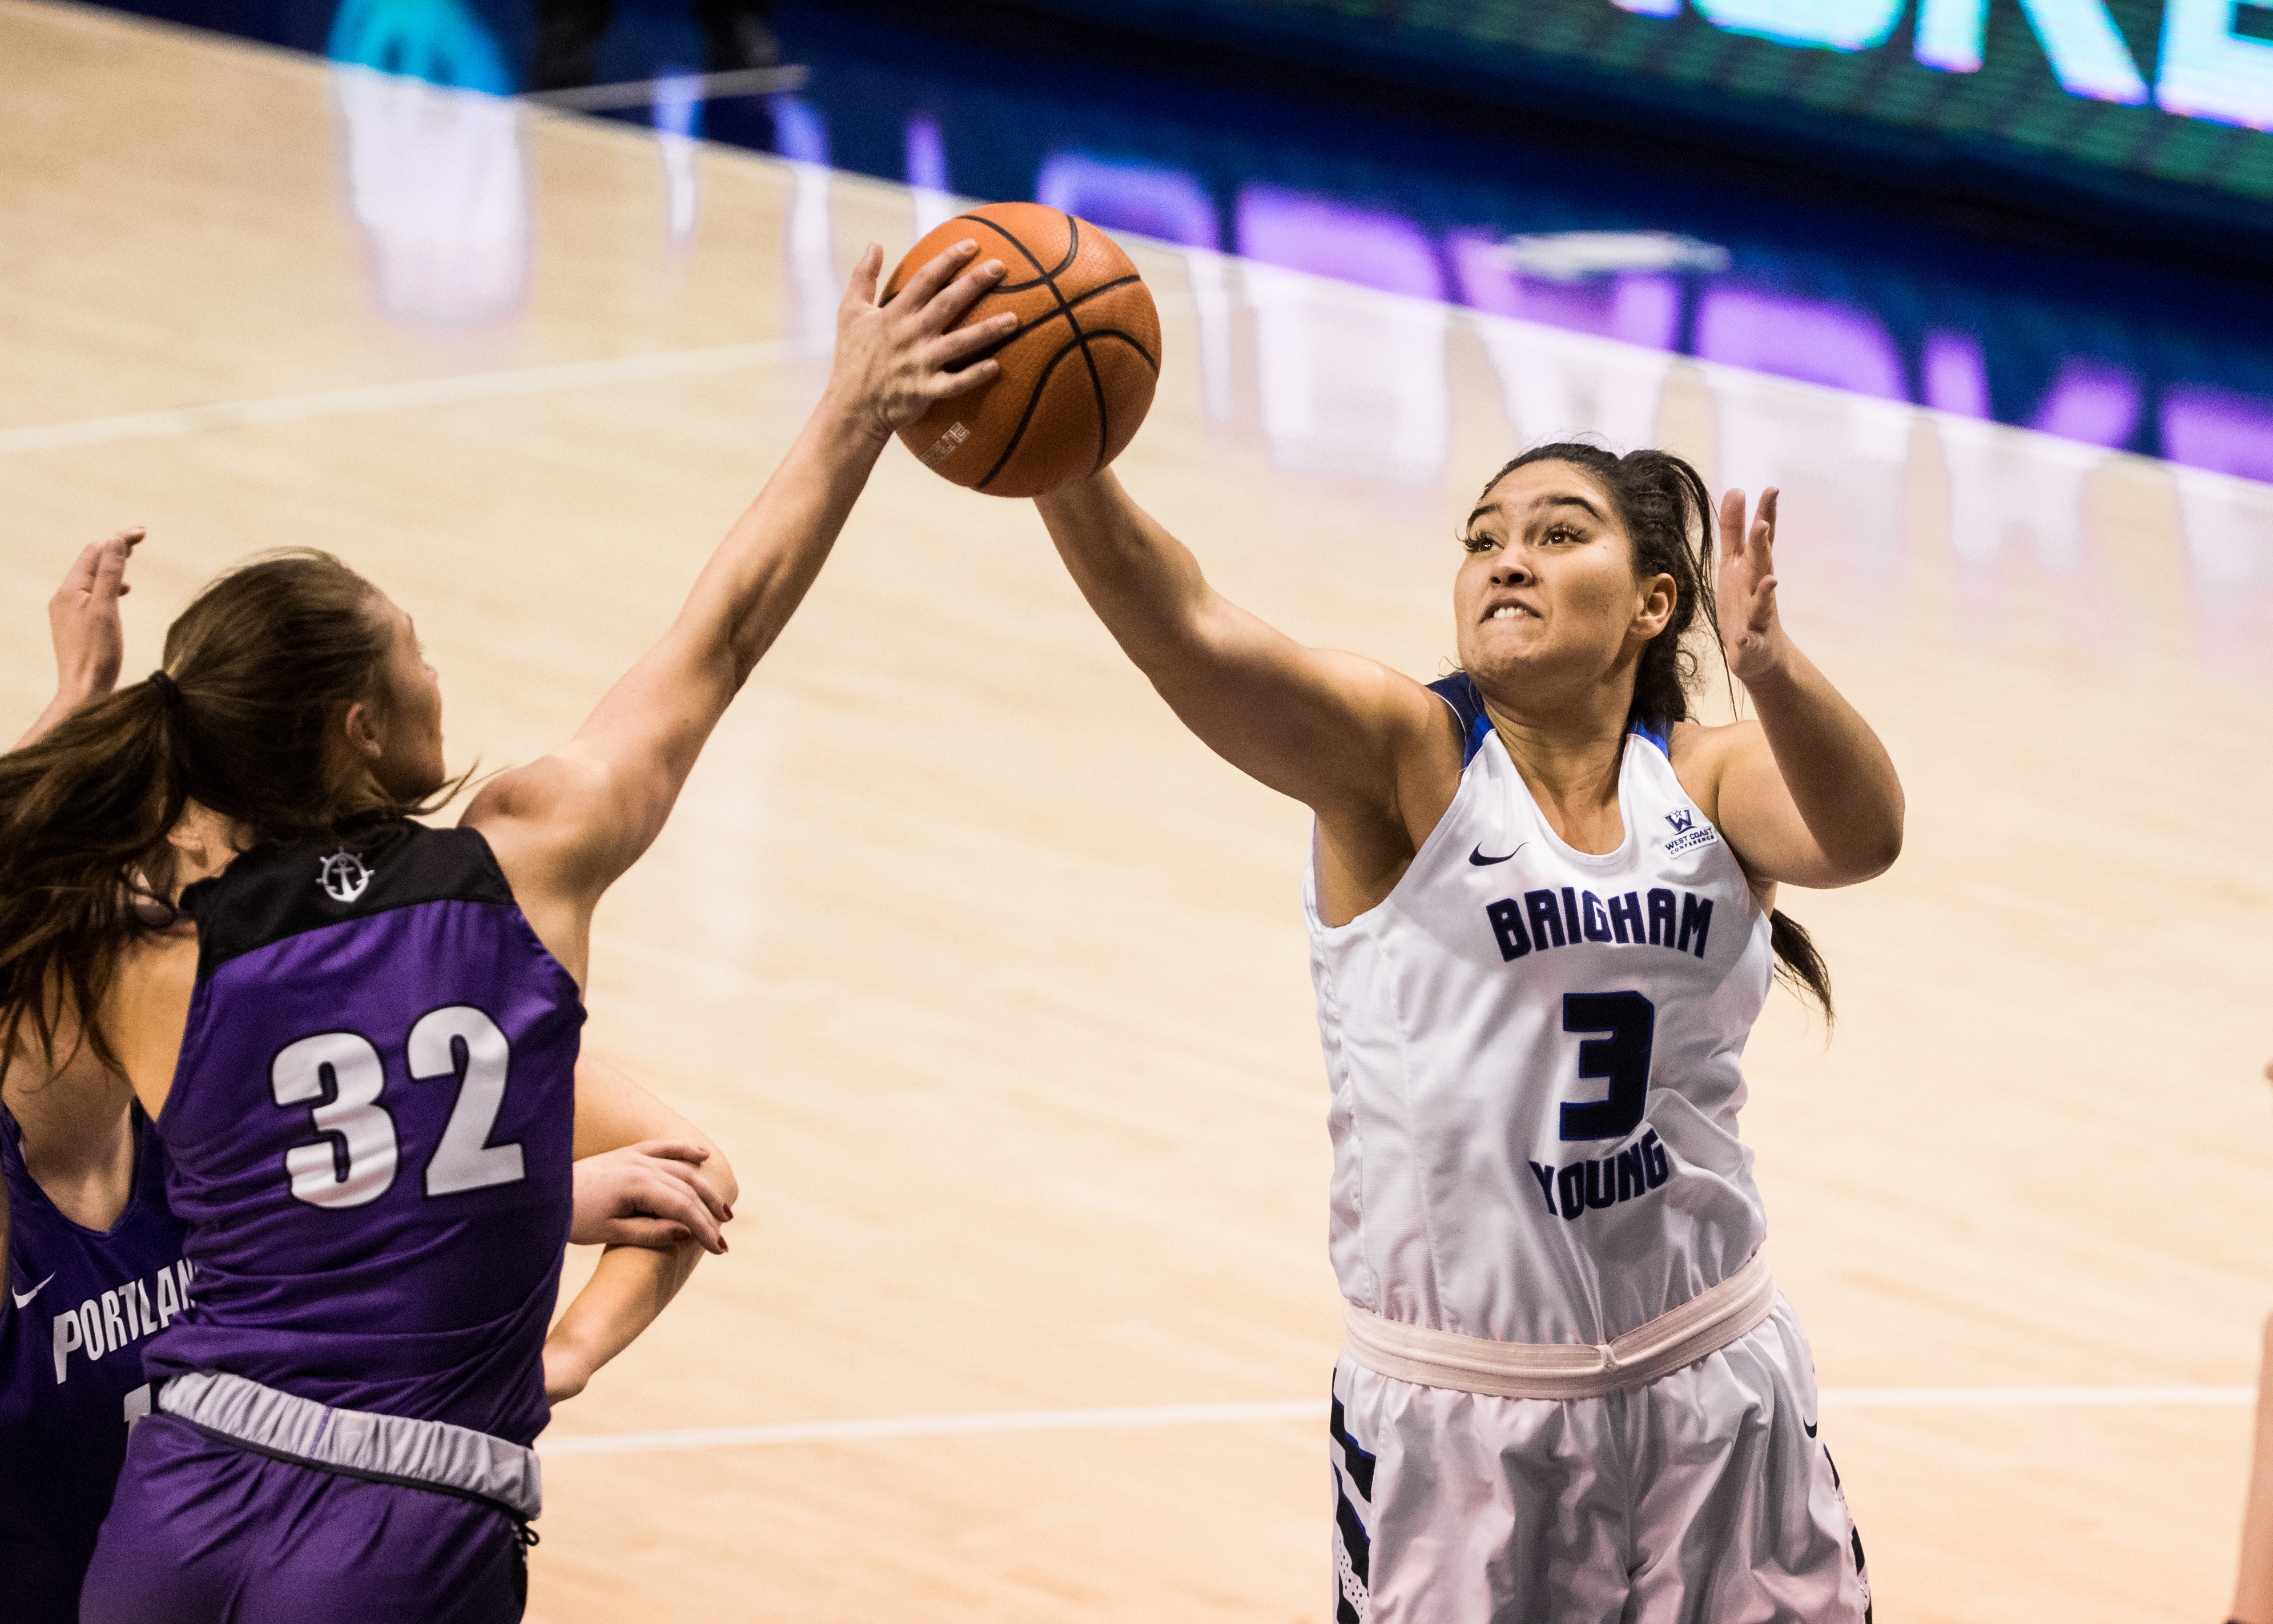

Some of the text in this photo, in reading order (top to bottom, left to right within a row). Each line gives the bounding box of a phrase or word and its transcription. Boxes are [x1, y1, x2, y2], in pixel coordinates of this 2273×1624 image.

[1665, 827, 1713, 851] WEST COAST
[1670, 835, 1715, 855] CONFERENCE
[1486, 887, 1715, 963] BRIGHAM
[271, 1004, 526, 1209] 32
[1559, 990, 1655, 1142] 3
[1528, 1127, 1669, 1221] YOUNG
[53, 1257, 199, 1385] PORTLAN
